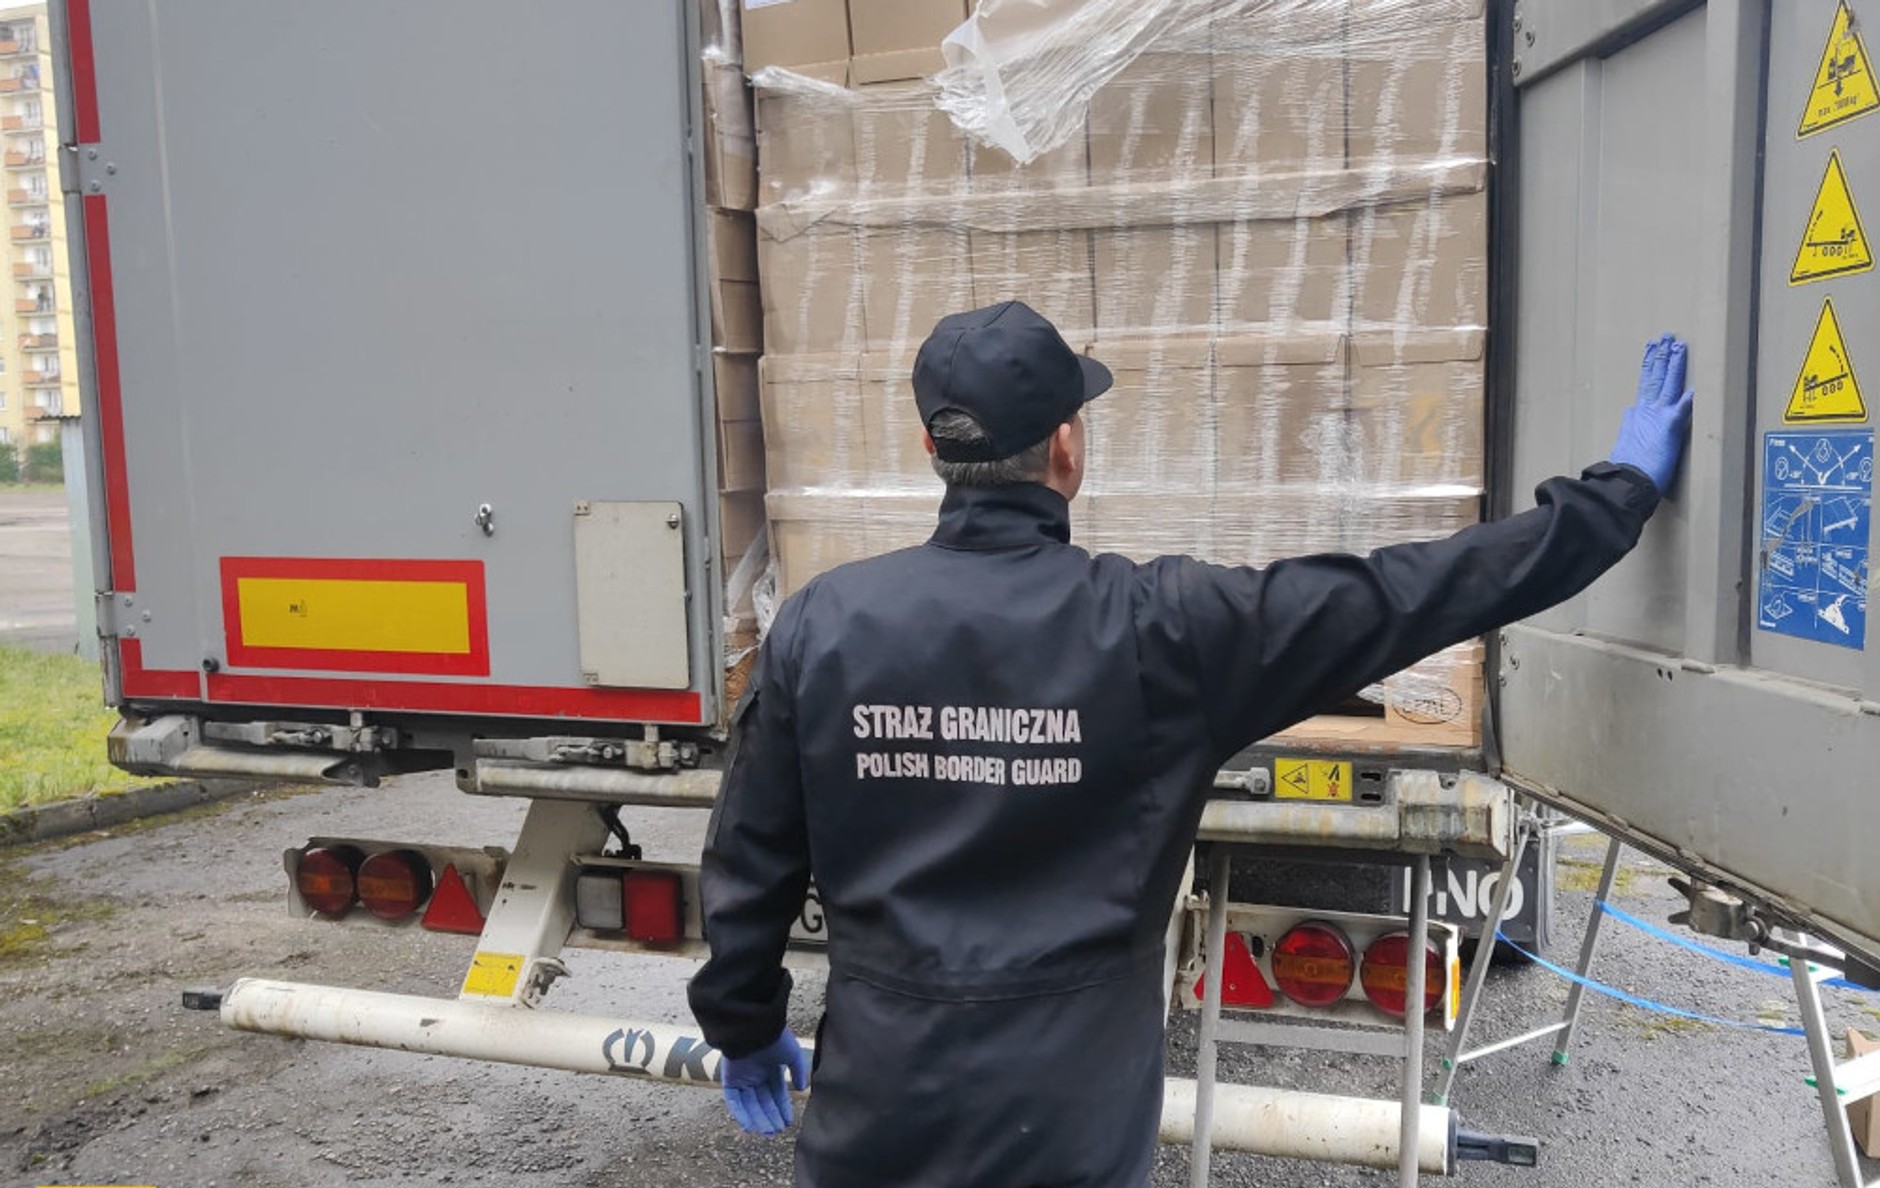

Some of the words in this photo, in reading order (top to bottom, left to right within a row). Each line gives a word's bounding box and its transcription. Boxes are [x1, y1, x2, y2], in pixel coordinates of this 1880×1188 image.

[940, 706, 1082, 743] GRANICZNA
[857, 752, 930, 779] POLISH
[934, 755, 1006, 785] BORDER
[1011, 758, 1083, 785] GUARD
